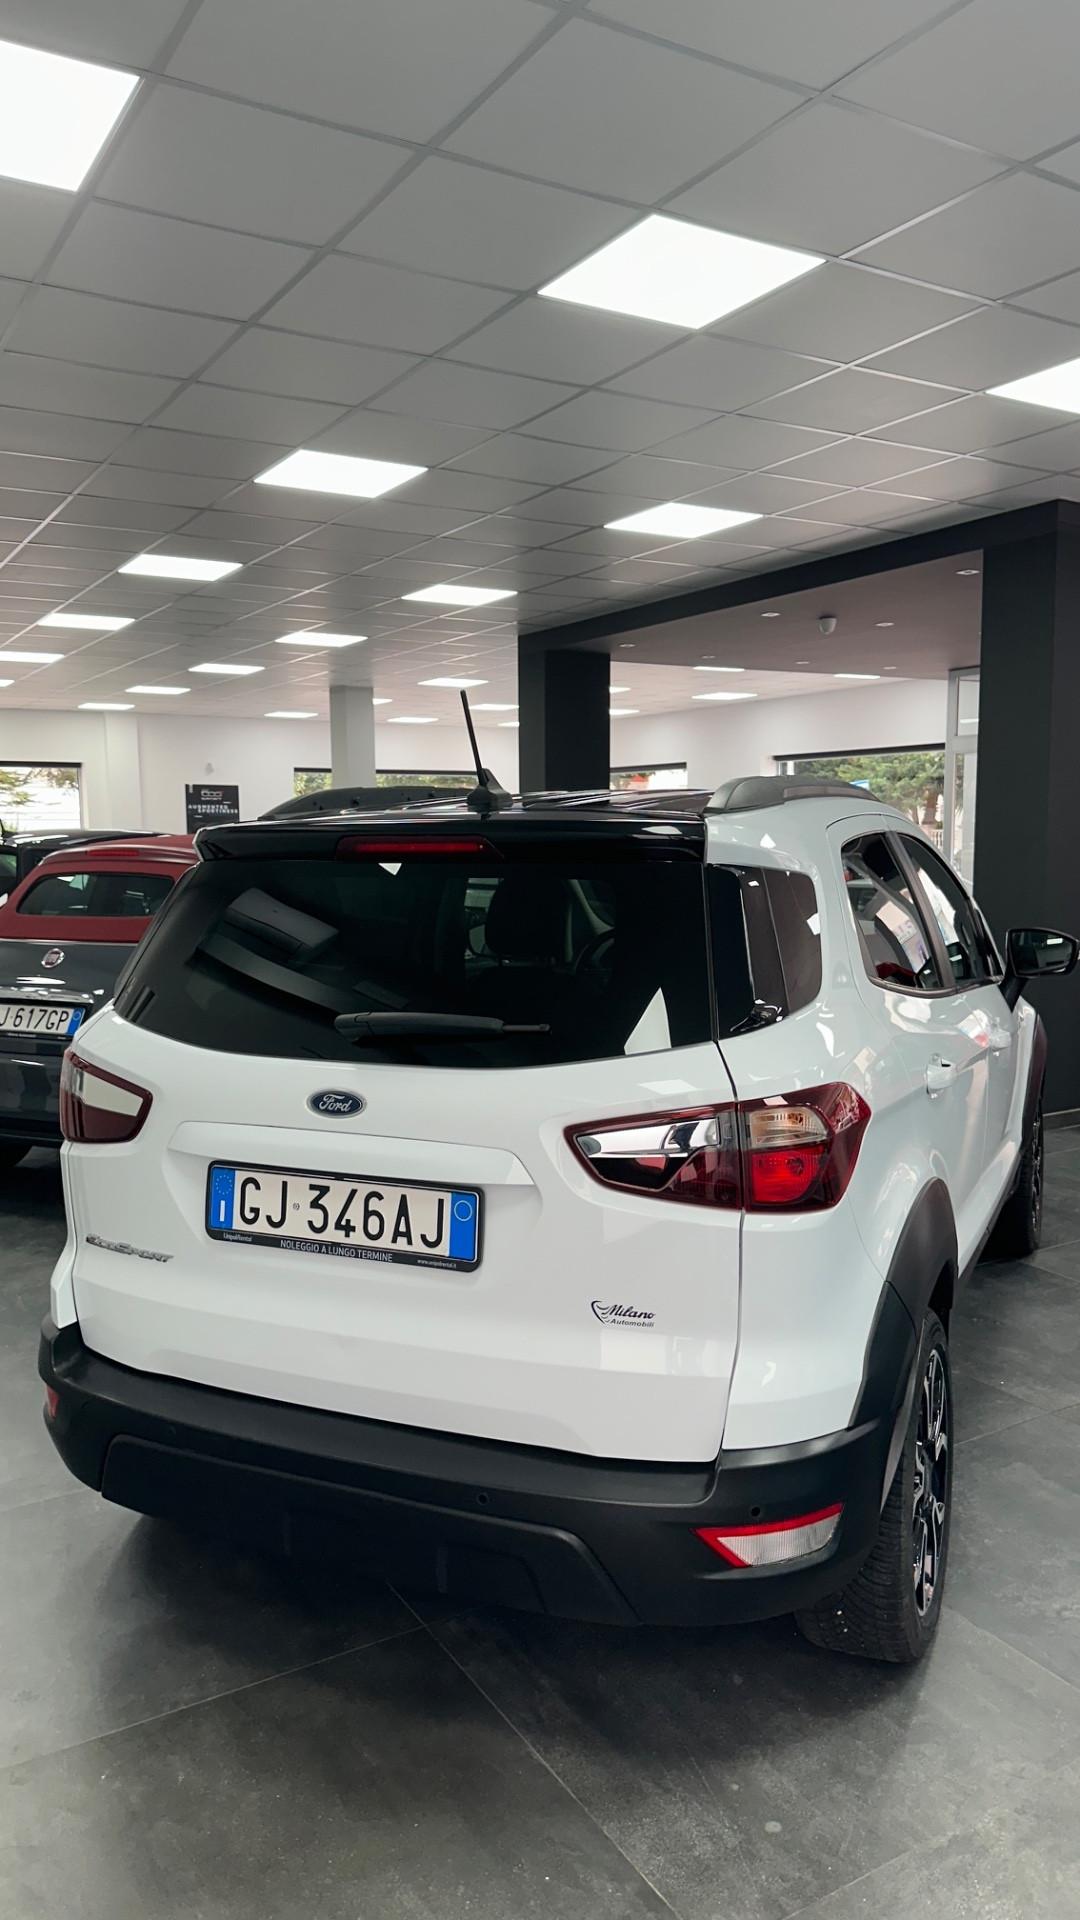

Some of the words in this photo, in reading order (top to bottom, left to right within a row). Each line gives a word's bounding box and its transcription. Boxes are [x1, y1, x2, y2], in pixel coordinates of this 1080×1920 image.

[13, 1007, 69, 1031] 617GP
[319, 1094, 353, 1112] Ford
[307, 1183, 445, 1249] 346AJ
[280, 1239, 320, 1253] NOLEGGIO
[321, 1246, 327, 1254] A
[328, 1247, 356, 1258] LUNGO
[357, 1249, 393, 1262] TERMINE
[601, 1304, 656, 1319] Milano
[610, 1319, 655, 1327] Automobili
